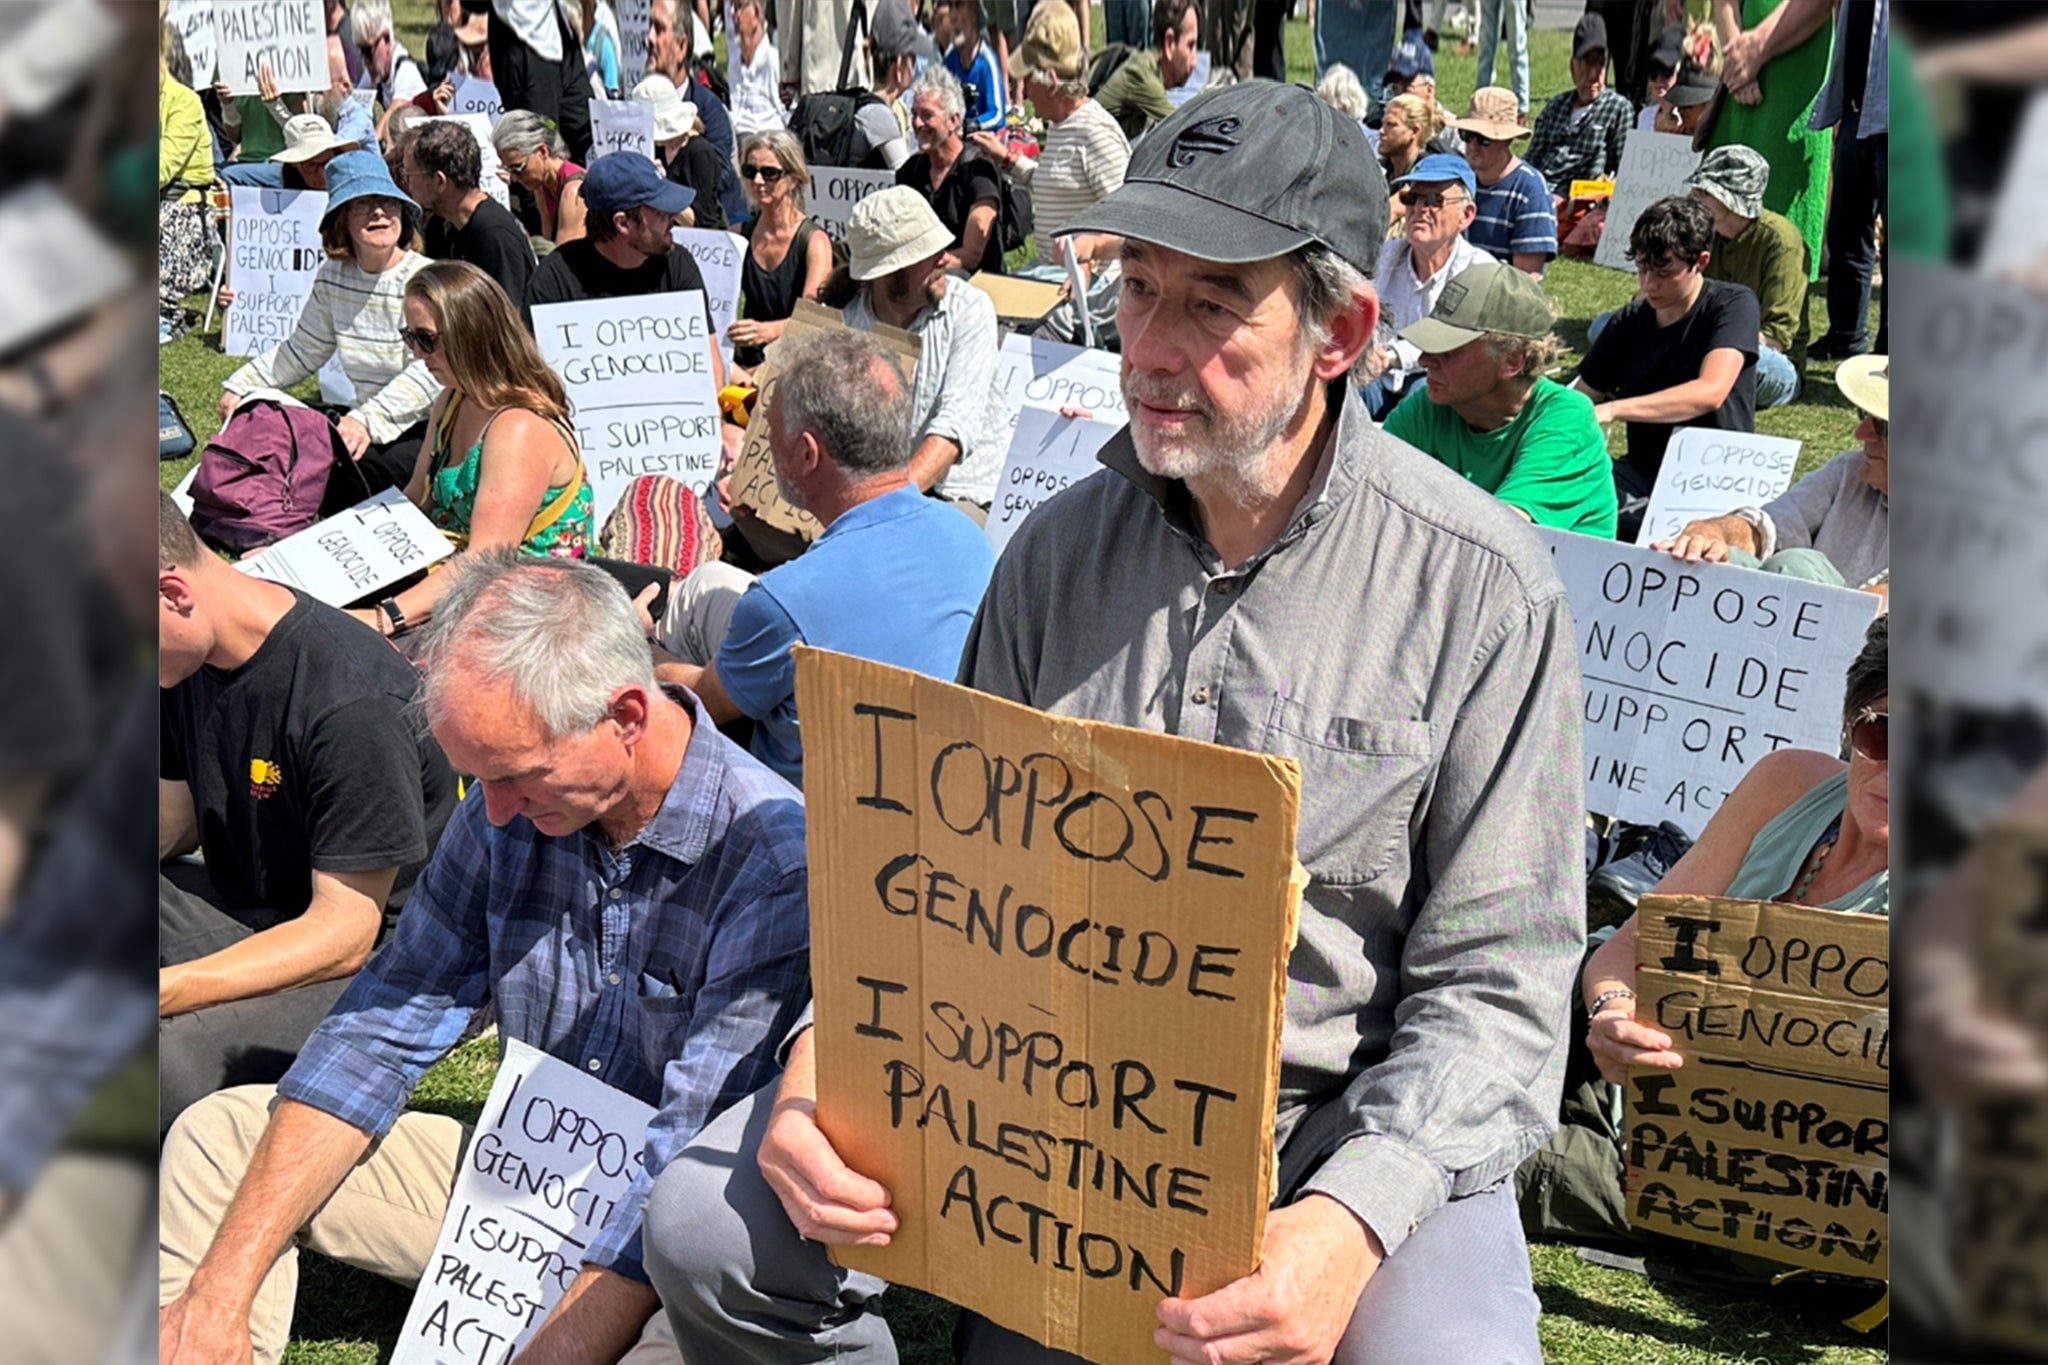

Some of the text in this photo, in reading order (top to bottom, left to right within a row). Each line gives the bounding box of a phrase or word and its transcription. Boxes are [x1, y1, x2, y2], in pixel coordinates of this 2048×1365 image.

[221, 1, 316, 44] PALESTINE
[275, 191, 283, 214] I
[810, 174, 817, 200] I
[236, 219, 300, 246] OPPOSE
[268, 274, 276, 294] I
[237, 293, 302, 316] SUPPORT
[557, 316, 705, 349] I OPPOSE
[563, 351, 708, 385] GENOCIDE
[577, 415, 721, 451] I SUPPORT
[1069, 430, 1081, 457] I
[600, 453, 715, 480] PALESTINE
[1676, 438, 1795, 476] I OPPOSE
[1671, 471, 1786, 501] GENOCIDE
[353, 501, 392, 526] I
[317, 530, 380, 590] GENOCIDE
[372, 521, 425, 566] OPPOSE
[1602, 561, 1823, 642] OPPOSE
[854, 703, 1259, 883] I OPPOSE
[875, 852, 1240, 1002] GENOCIDE
[1660, 916, 1721, 976] I
[855, 975, 1238, 1147] I SUPPORT
[497, 1073, 523, 1129] I
[1633, 1074, 1681, 1118] I
[885, 1060, 1210, 1217] PALESTINE
[454, 1204, 470, 1244] I
[940, 1165, 1187, 1298] ACTION
[1636, 1181, 1882, 1265] ACTION
